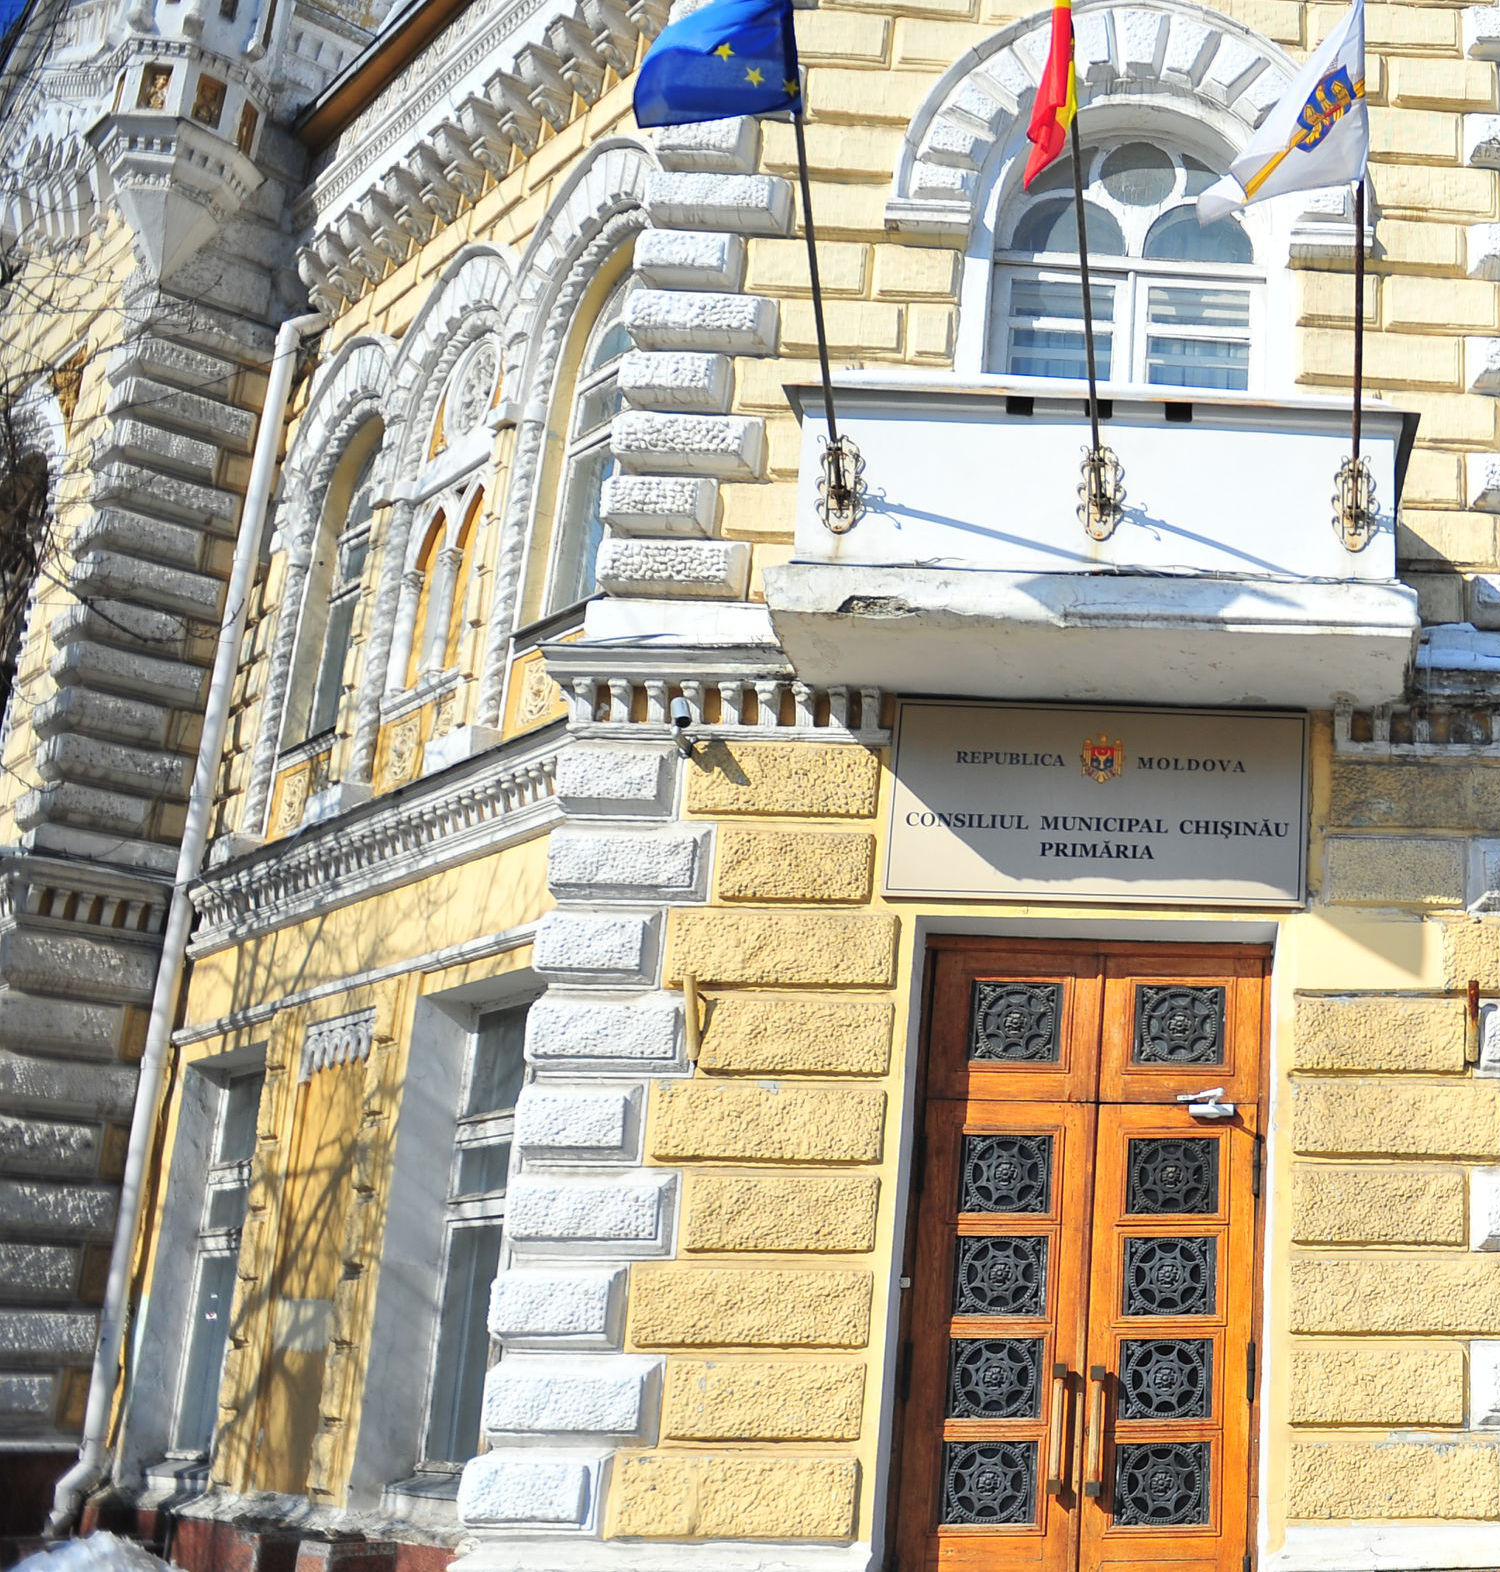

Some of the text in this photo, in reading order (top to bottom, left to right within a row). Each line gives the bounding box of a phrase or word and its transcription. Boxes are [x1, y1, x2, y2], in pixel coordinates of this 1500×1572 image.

[956, 751, 1246, 773] REPUBLICA MOLDOVA
[905, 811, 1029, 830] CONSILIUL
[1040, 815, 1169, 834] MUNICIPAL
[1039, 840, 1155, 860] PRIMĂRIA
